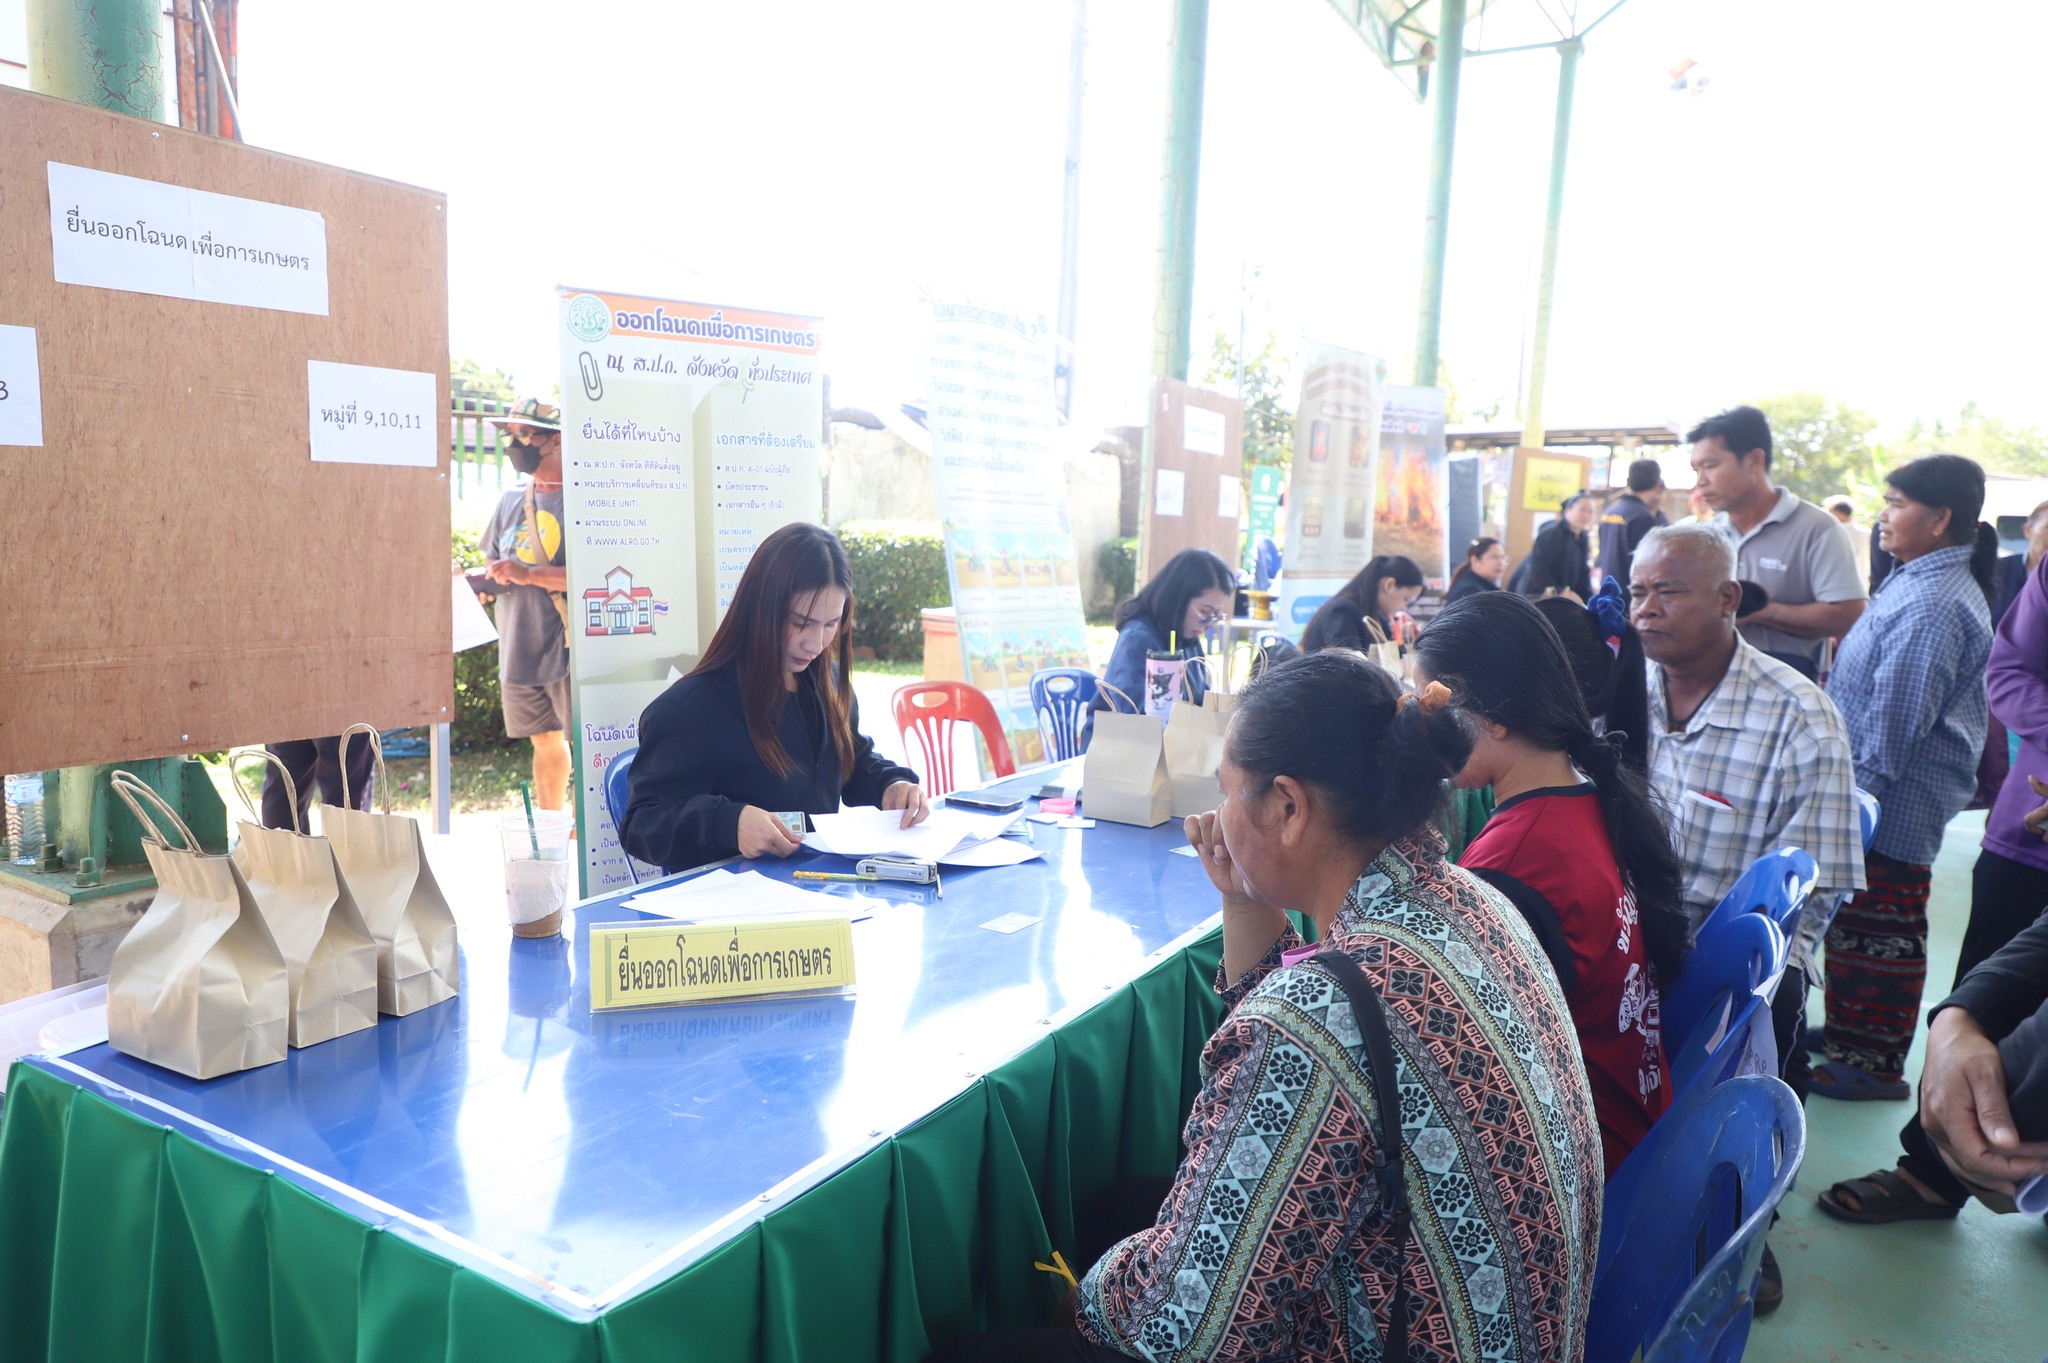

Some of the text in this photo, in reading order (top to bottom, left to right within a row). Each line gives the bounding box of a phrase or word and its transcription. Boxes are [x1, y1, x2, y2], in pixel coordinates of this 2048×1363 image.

[616, 308, 816, 348] ออกโฉนดเพื่อการเกษตร
[633, 354, 678, 375] ส.ป.ก.
[686, 354, 739, 380] จังหวัด
[747, 355, 812, 385] ทั่วประเทศ
[320, 400, 422, 431] หมู่ที่ 9,10,11
[582, 416, 681, 443] ยื่นได้ที่ไหนบ้าง
[716, 426, 816, 449] เอกสารที่ต้องเตรียม
[584, 499, 617, 508] (MOBILE
[623, 518, 648, 527] ONLINE
[617, 926, 833, 992] ยื่นออกโฉนดเพื่อการเกษตร
